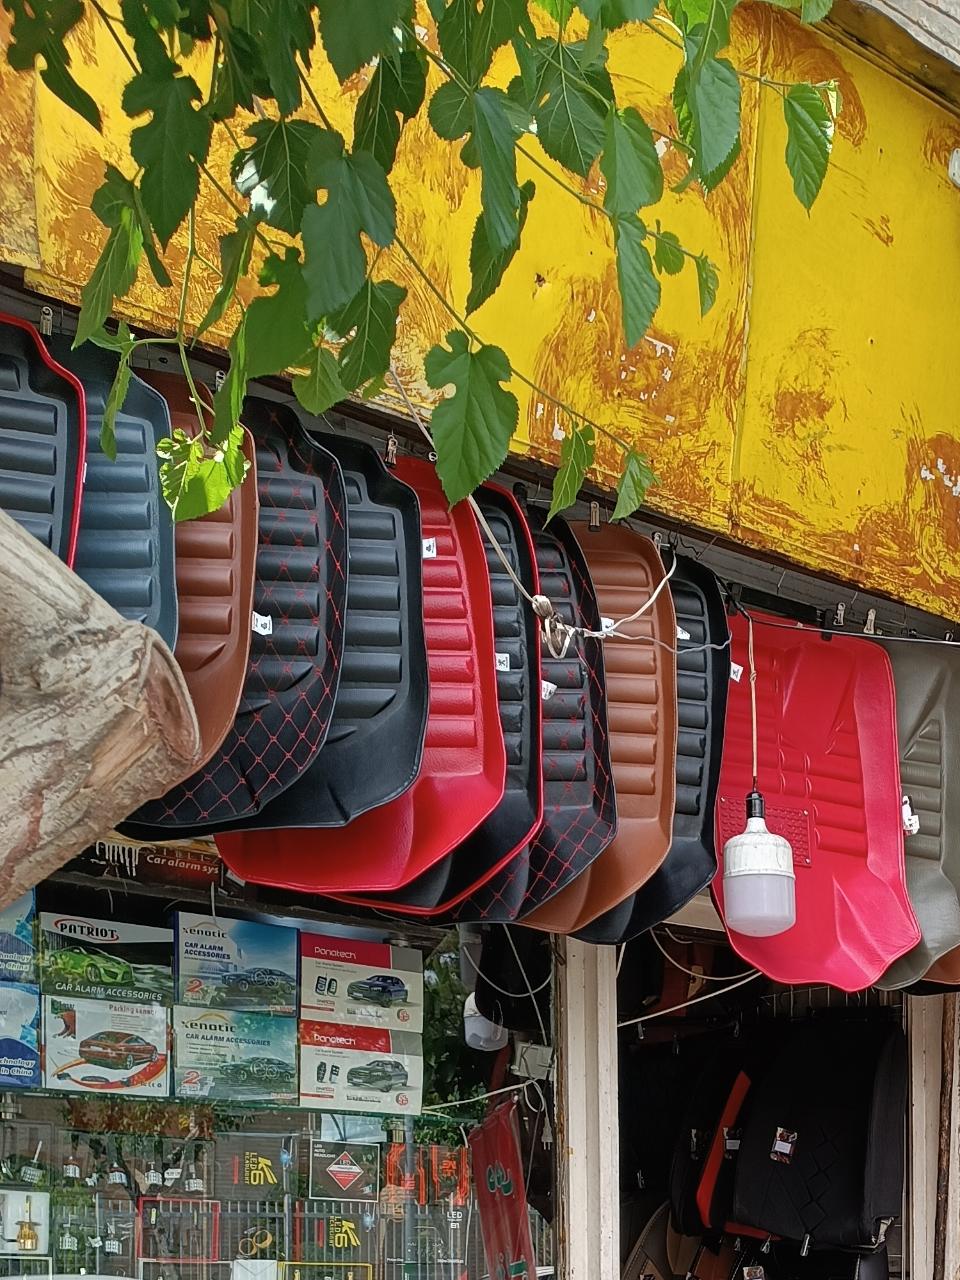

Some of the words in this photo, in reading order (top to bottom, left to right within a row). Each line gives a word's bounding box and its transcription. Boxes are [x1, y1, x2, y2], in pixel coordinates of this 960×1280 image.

[147, 855, 167, 865] Car
[167, 858, 201, 871] alarm
[60, 922, 118, 939] PATRIOT
[200, 943, 224, 952] ALARM
[184, 948, 231, 960] ACCESSORIES
[55, 982, 72, 991] CAR
[74, 984, 104, 994] ALARM
[105, 988, 163, 1001] ACCESSORIES
[201, 1035, 225, 1043] ALARM
[226, 1037, 271, 1047] ACCESSORIES
[10, 1068, 33, 1076] China
[447, 1211, 463, 1219] LED
